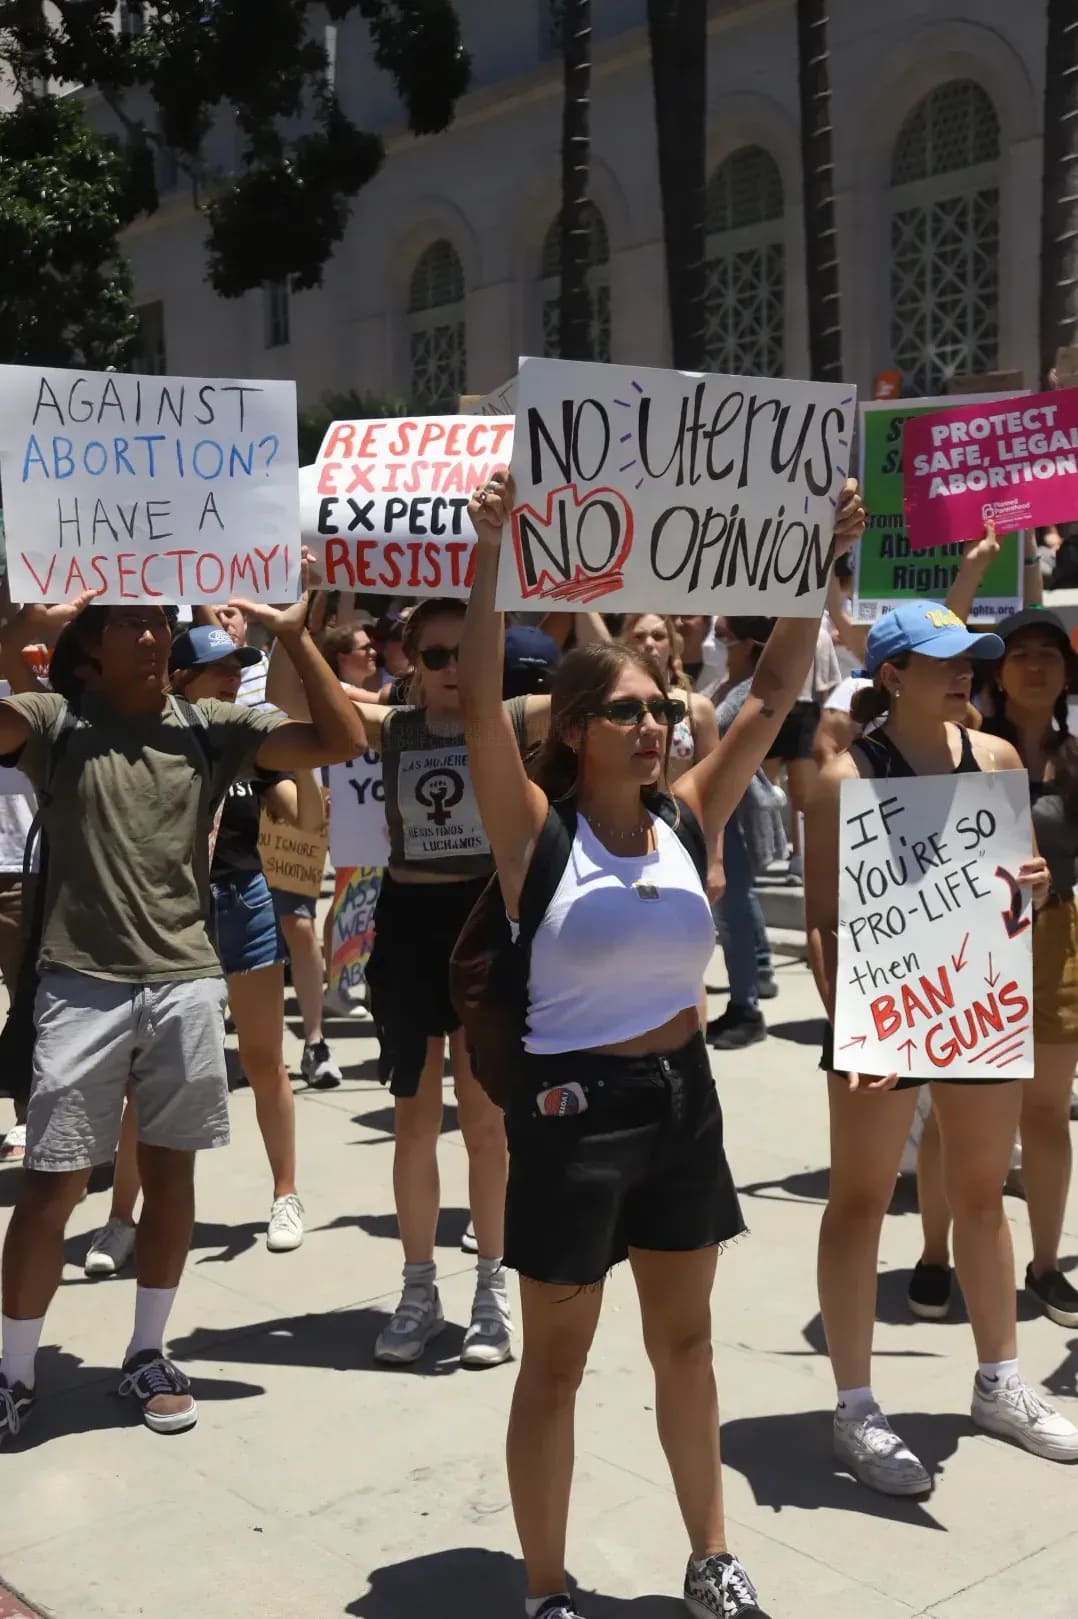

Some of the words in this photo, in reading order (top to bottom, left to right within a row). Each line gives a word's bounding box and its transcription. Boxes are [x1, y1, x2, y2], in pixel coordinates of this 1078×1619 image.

[33, 377, 264, 432] AGAINST
[931, 405, 1058, 447] PROTECT
[22, 434, 279, 482] ABORTION?
[323, 421, 514, 458] RESPECT
[528, 399, 610, 485] NO
[913, 444, 992, 477] SAFE,
[928, 454, 1078, 499] ABORTION
[58, 498, 173, 548] HAVE
[199, 491, 224, 531] A
[317, 497, 469, 535] EXPECT
[866, 514, 903, 529] rom
[519, 499, 621, 587] NO
[21, 544, 289, 598] VASECTOMY!
[275, 836, 320, 858] IGNORE
[846, 797, 905, 850] IF
[845, 832, 952, 905] YOU'RE
[956, 809, 997, 851] SO
[849, 951, 920, 995] then
[870, 965, 956, 1041] BAN
[925, 980, 1030, 1068] GUNS
